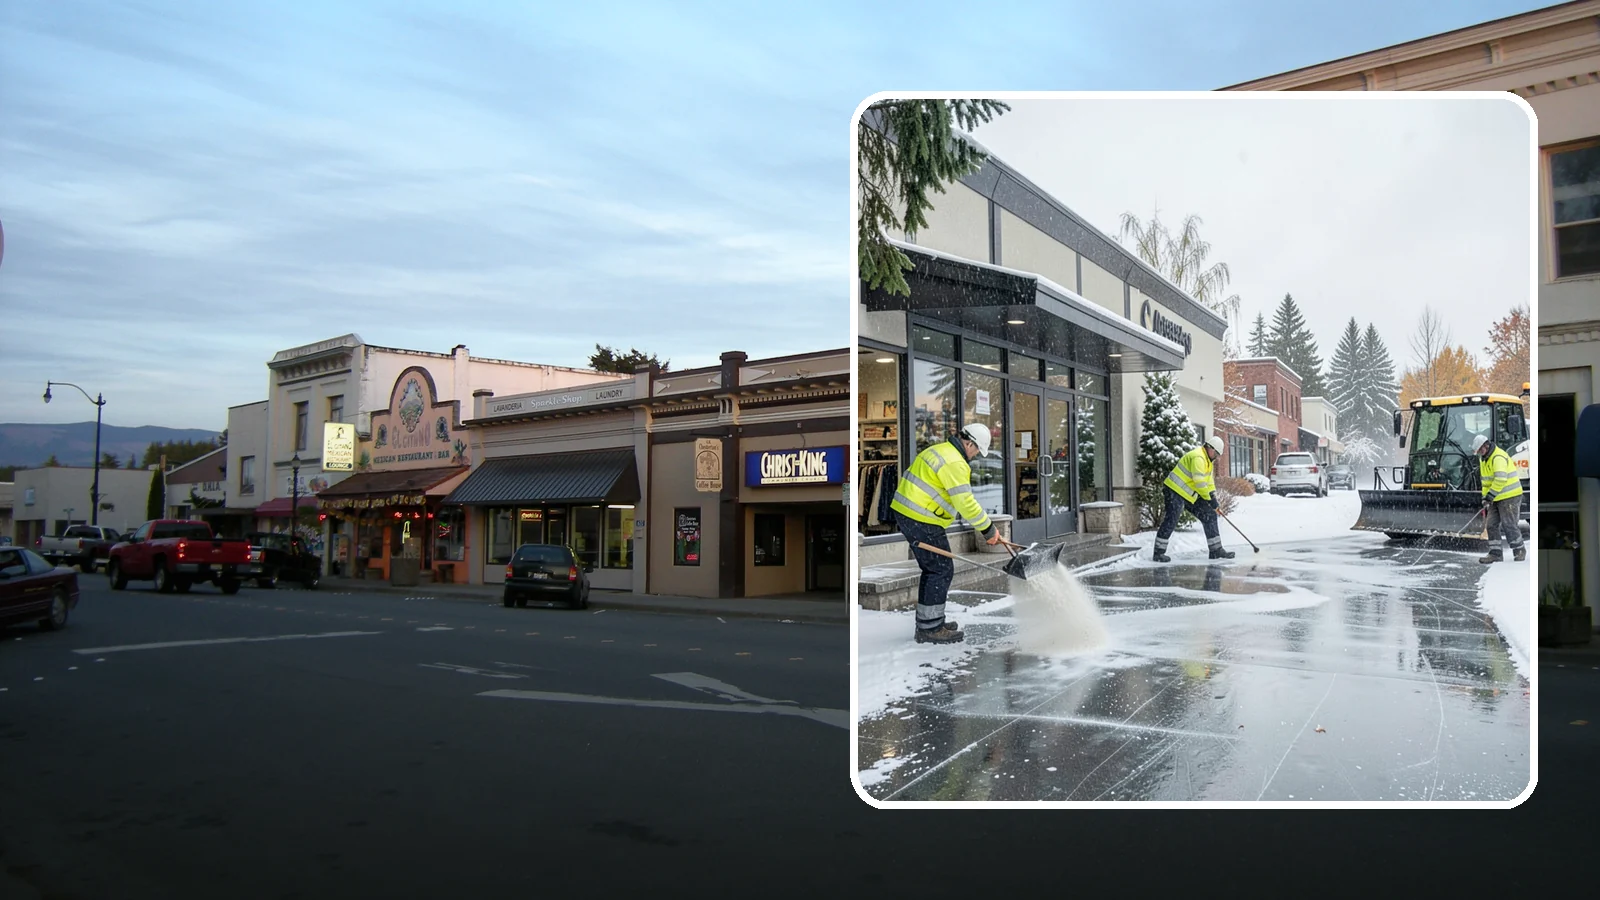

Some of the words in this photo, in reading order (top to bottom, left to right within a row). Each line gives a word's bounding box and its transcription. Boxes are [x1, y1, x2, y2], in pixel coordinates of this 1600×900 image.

[493, 402, 522, 413] LAVANDERIA
[531, 398, 561, 409] Sparkle
[562, 394, 582, 405] Shop
[595, 389, 623, 400] LAUNDRY
[373, 455, 396, 464] MEXICAN
[397, 451, 433, 463] RESTAURANT
[438, 450, 450, 459] BAR
[761, 452, 797, 478] CHRIST
[799, 450, 827, 476] KING
[696, 481, 709, 489] Coffee
[709, 481, 722, 489] House
